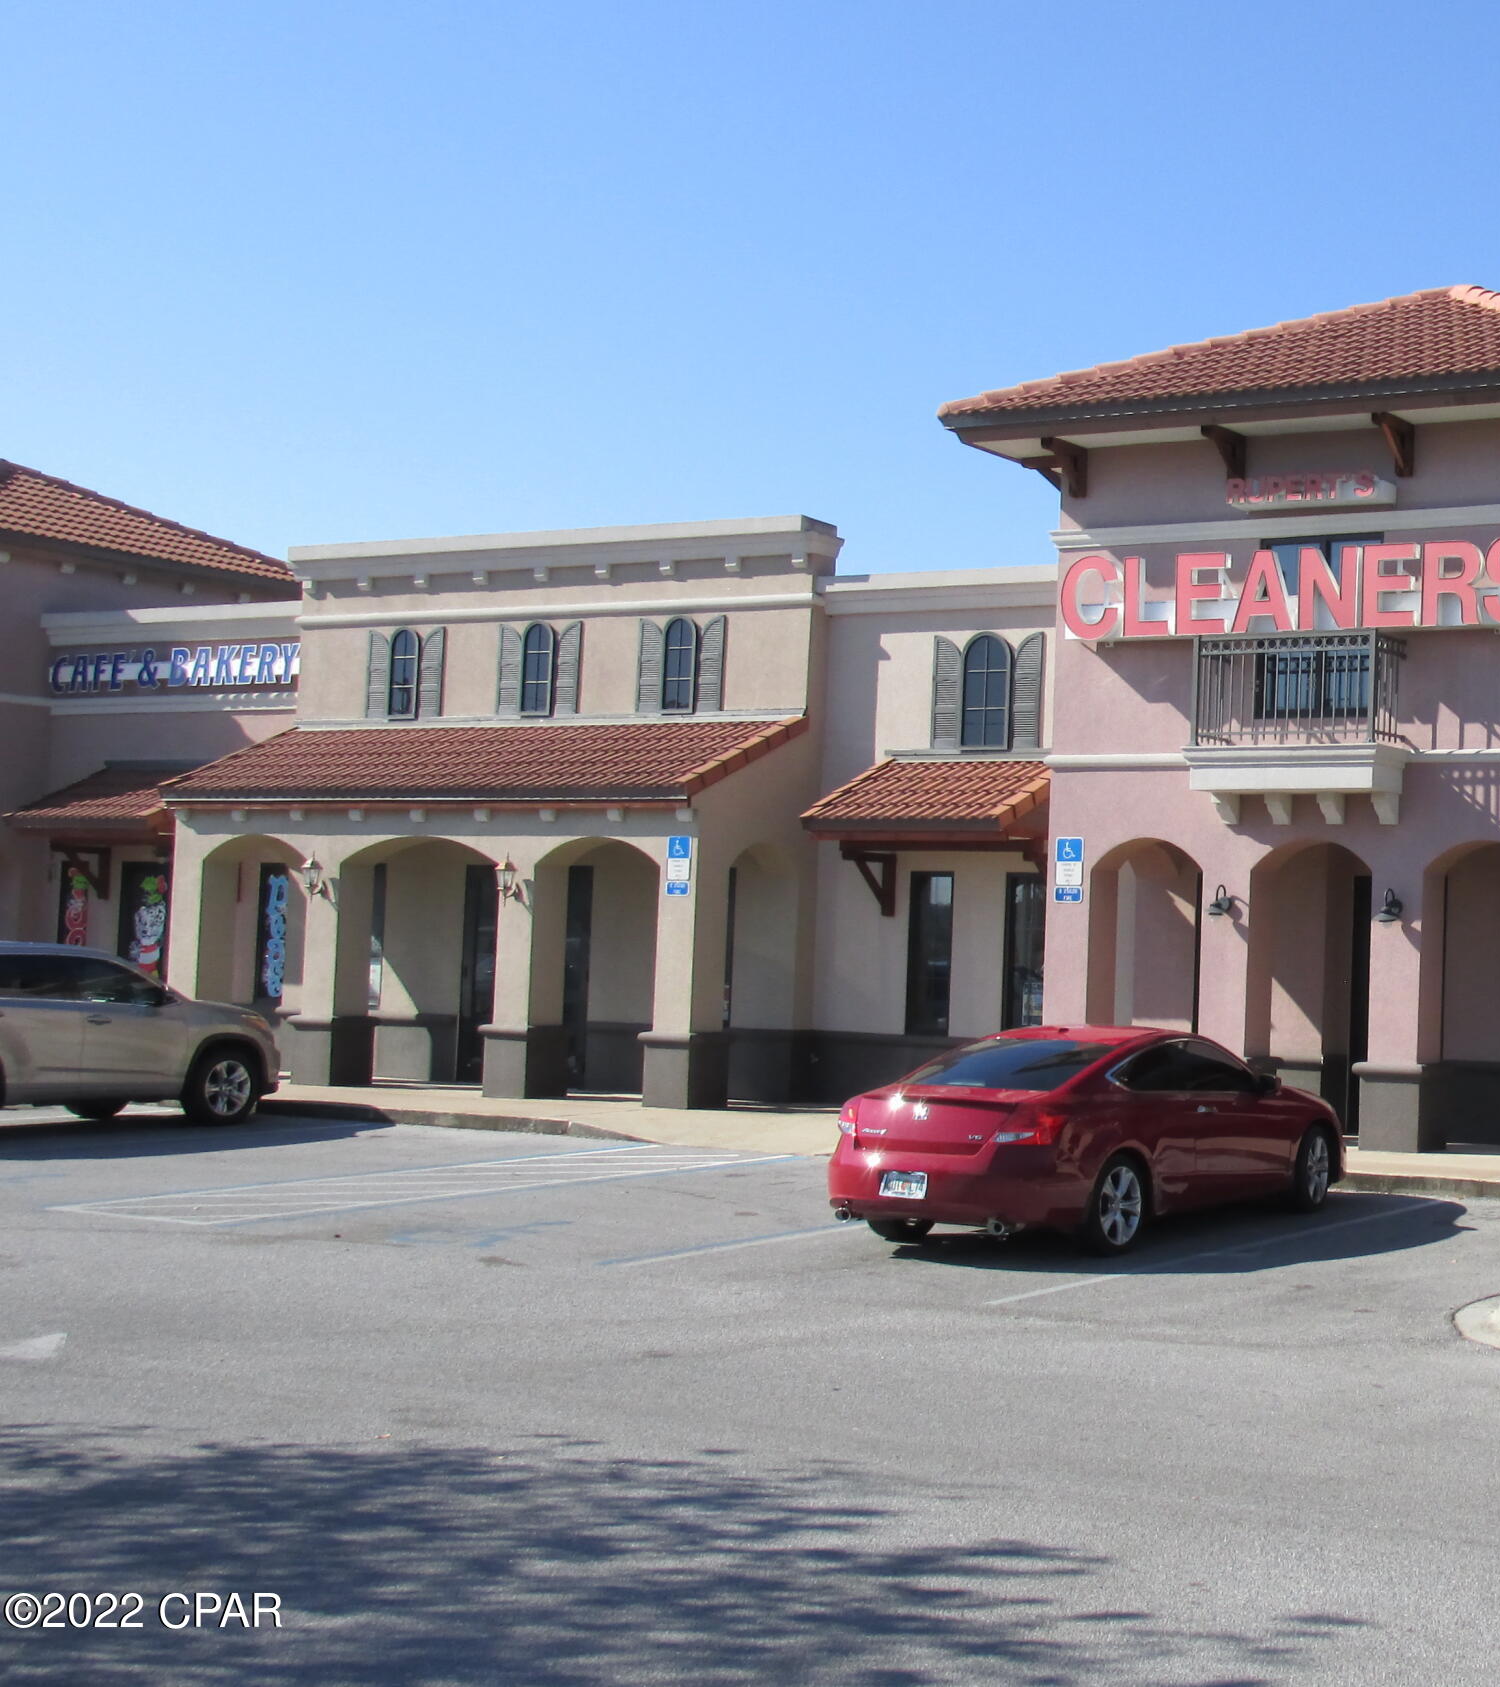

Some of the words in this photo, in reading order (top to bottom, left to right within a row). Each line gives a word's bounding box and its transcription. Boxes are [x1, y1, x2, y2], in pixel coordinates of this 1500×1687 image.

[1227, 472, 1375, 503] RUPERT'S
[136, 648, 161, 690] &
[167, 642, 299, 688] BAKERY
